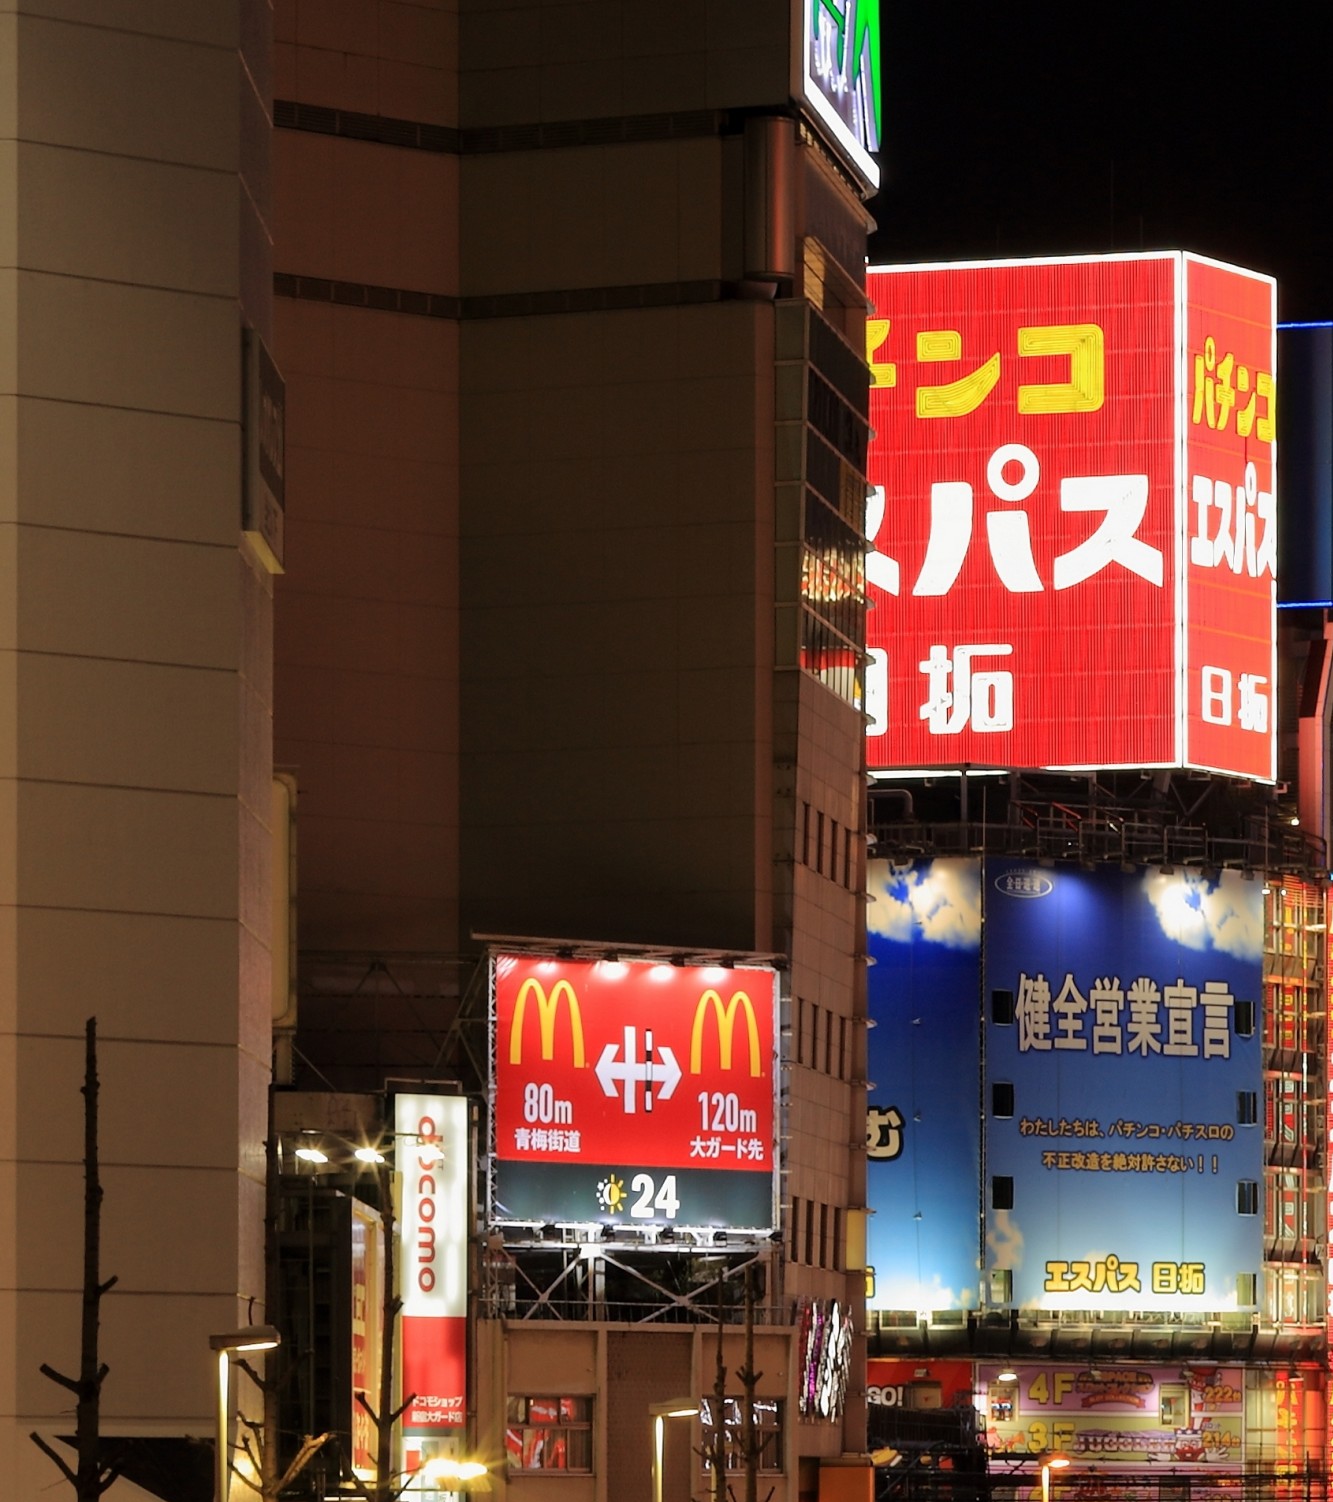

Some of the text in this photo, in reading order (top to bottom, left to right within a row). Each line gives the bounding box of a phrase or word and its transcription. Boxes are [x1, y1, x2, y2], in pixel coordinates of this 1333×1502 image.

[1192, 335, 1276, 444] パチンコ
[1201, 665, 1269, 733] 日拓
[1015, 973, 1235, 1061] 健全営業宣言
[523, 1083, 573, 1125] 80m
[697, 1091, 758, 1134] 120m
[514, 1127, 582, 1154] 青梅街道
[689, 1138, 764, 1161] 大ガード先
[1018, 1117, 1235, 1141] わたしたちは、パチンコ・パチスロの
[1041, 1152, 1219, 1175] 不正改造を絶対許さない！！
[630, 1173, 681, 1220] 24
[1044, 1254, 1206, 1295] エスパス 日拓
[1027, 1371, 1077, 1406] 4F
[1027, 1421, 1077, 1454] 3F
